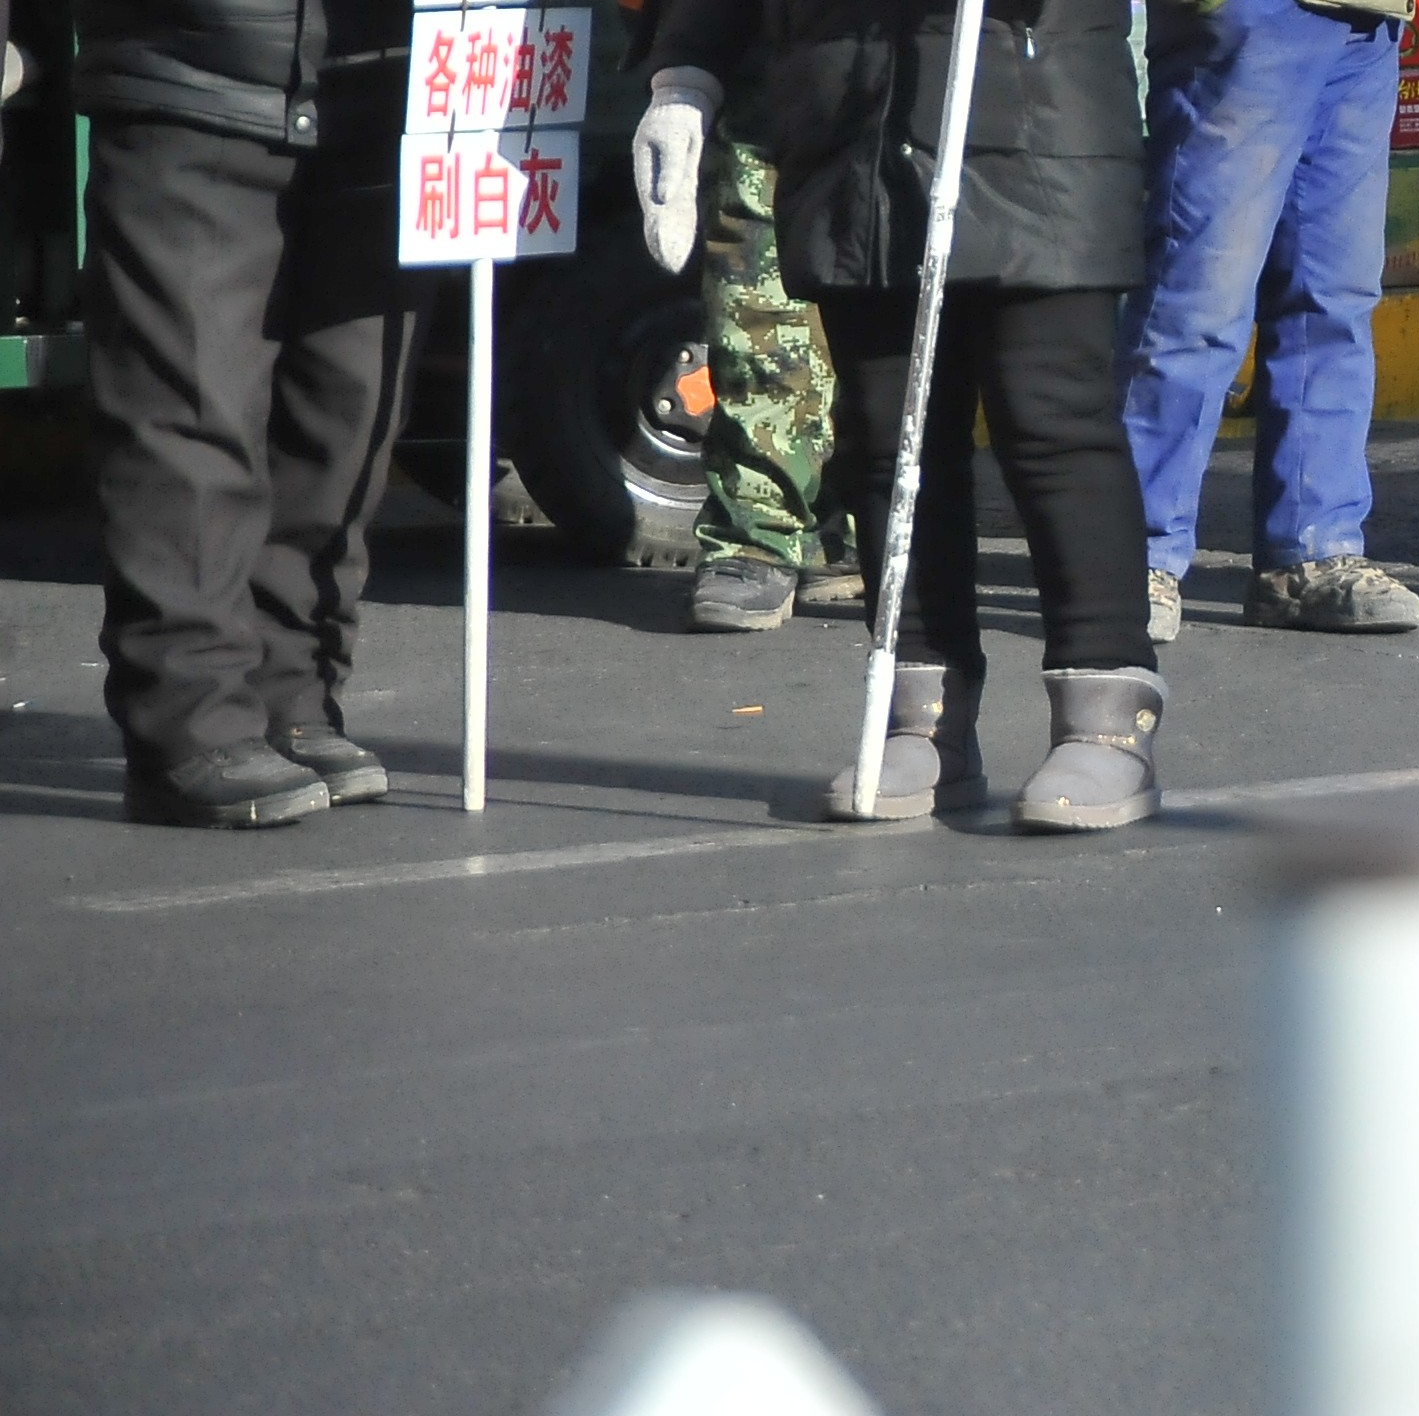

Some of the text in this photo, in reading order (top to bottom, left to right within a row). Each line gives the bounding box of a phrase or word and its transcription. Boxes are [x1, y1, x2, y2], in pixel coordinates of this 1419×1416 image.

[424, 24, 575, 118] 各种油漆
[415, 148, 563, 241] 刷白灰
